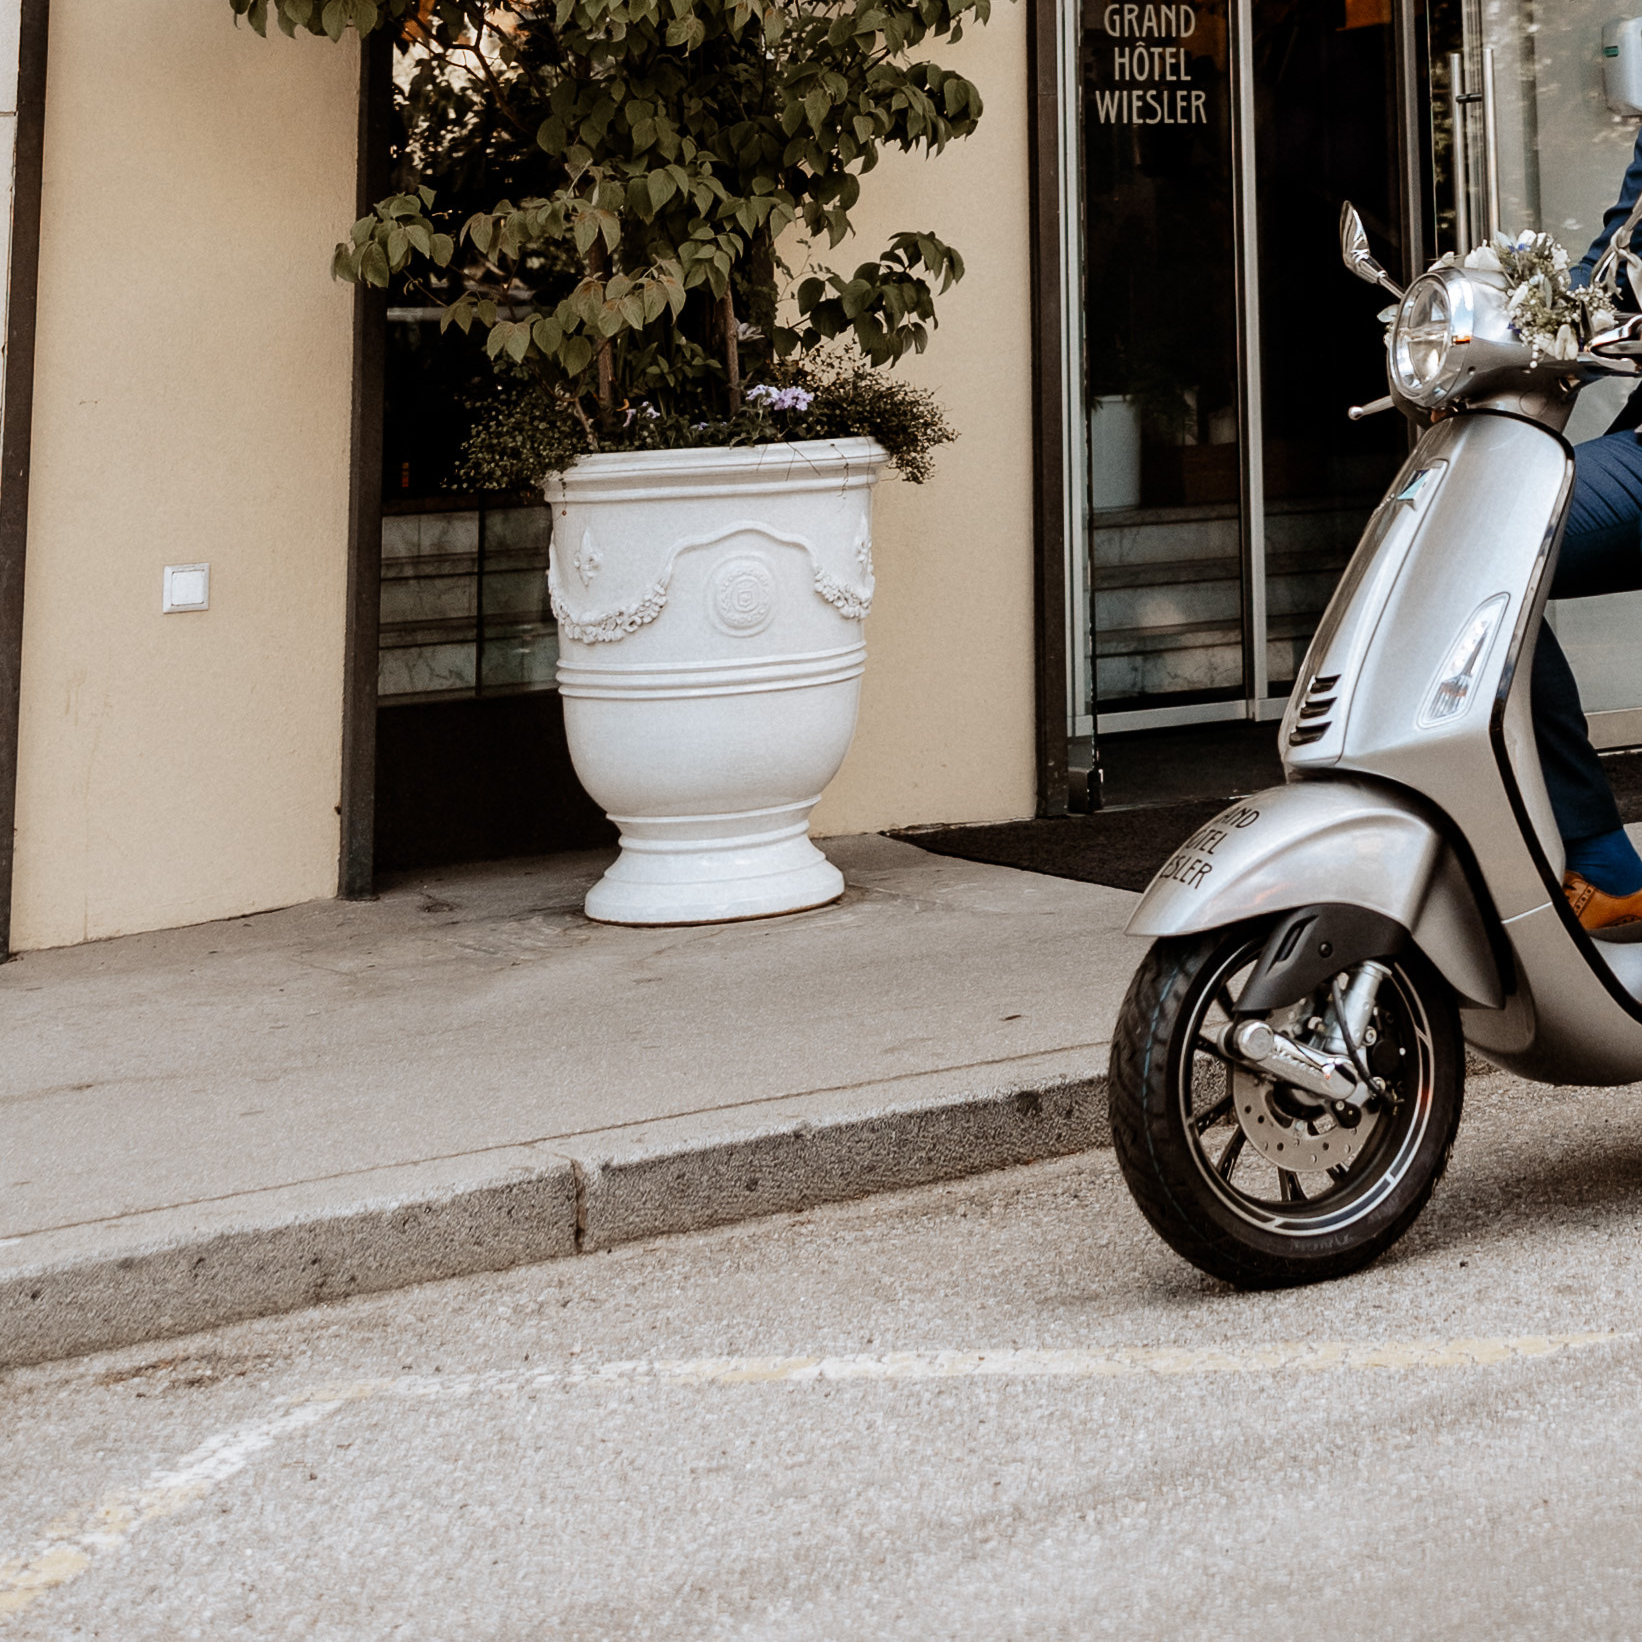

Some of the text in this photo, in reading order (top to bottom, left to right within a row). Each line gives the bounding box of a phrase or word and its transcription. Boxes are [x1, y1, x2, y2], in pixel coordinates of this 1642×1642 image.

[1103, 3, 1196, 38] GRAND
[1114, 41, 1192, 81] HÔTEL
[1095, 89, 1208, 125] WIESLER
